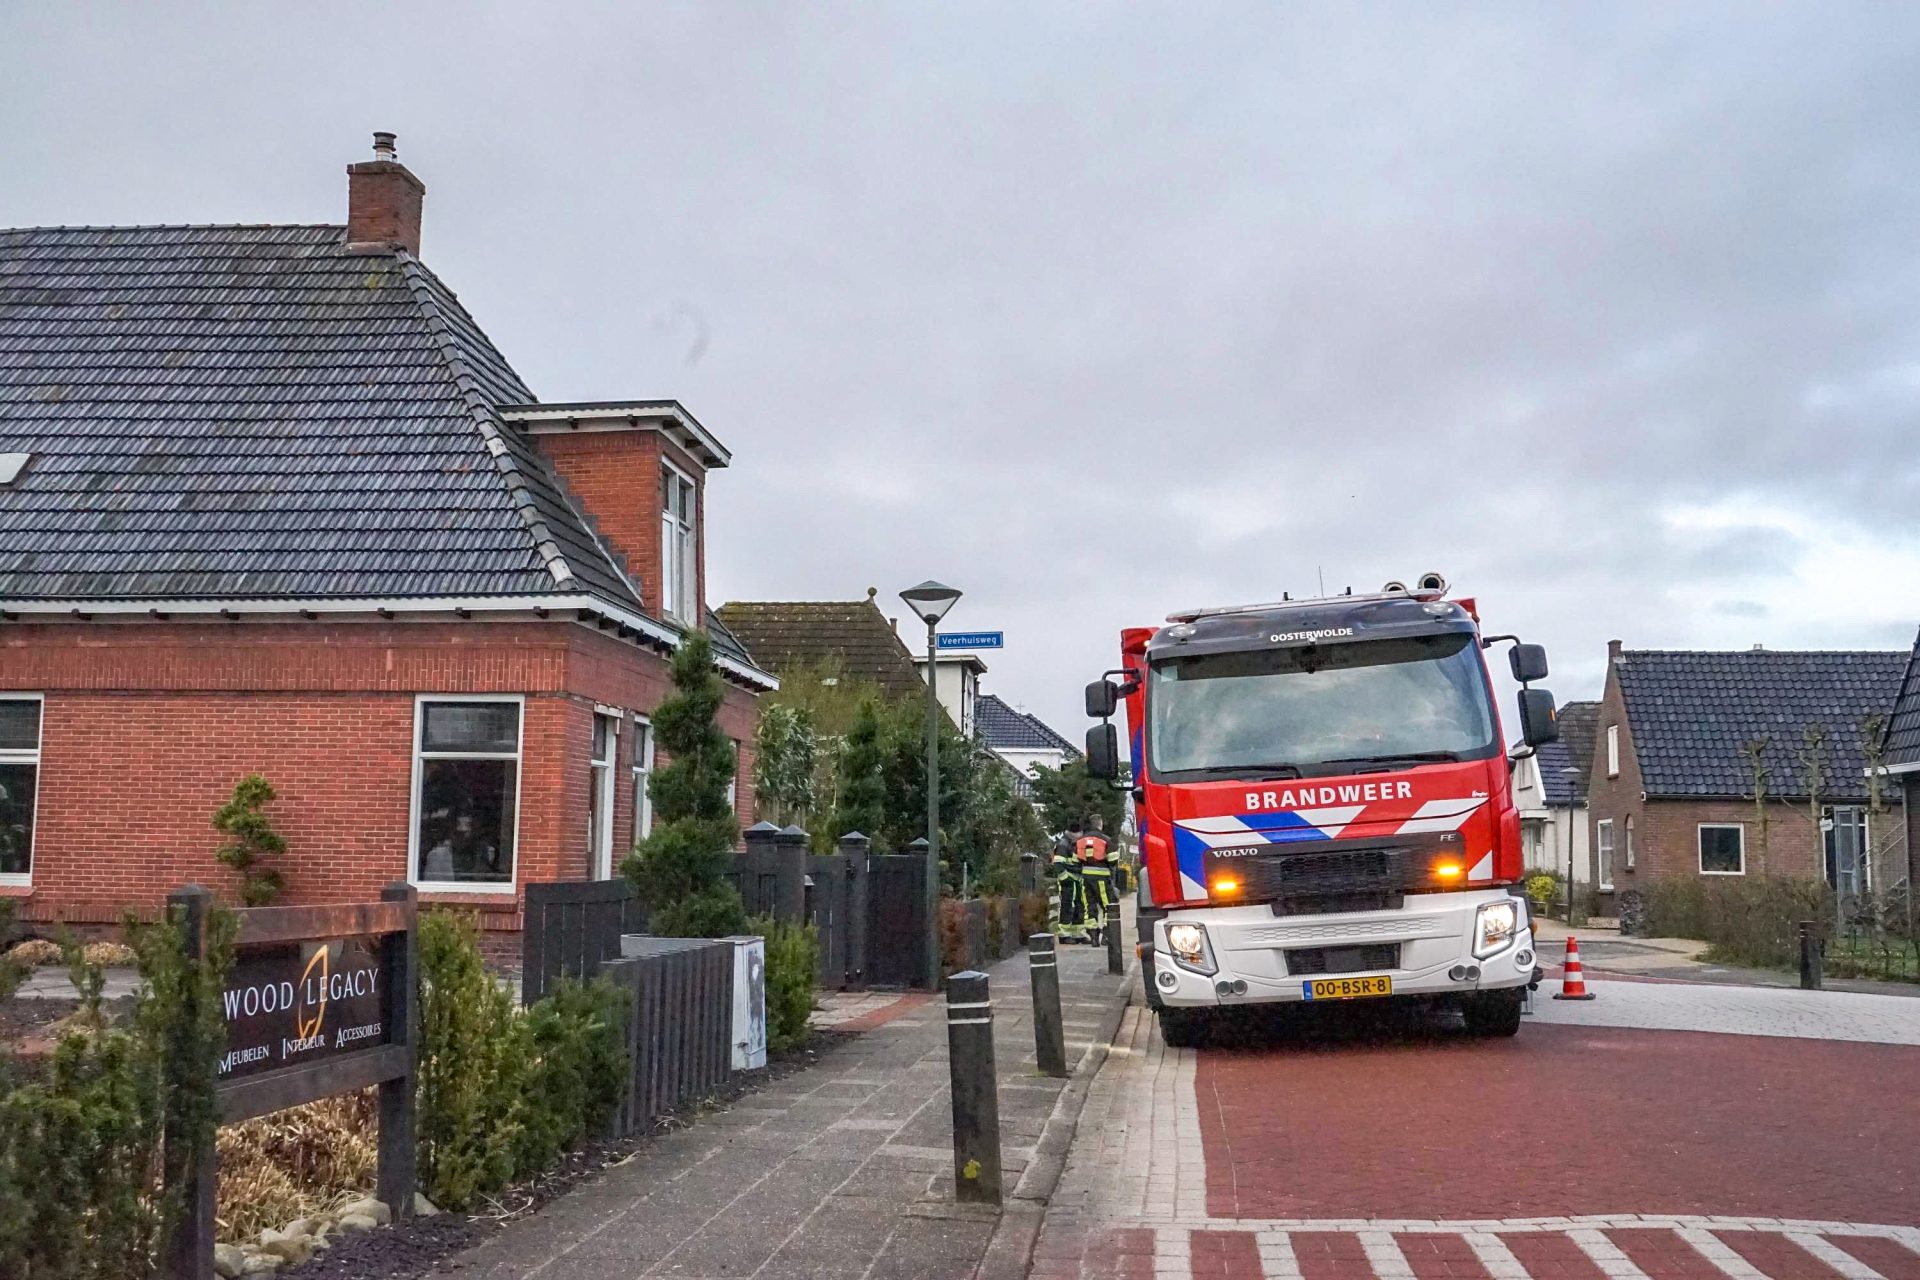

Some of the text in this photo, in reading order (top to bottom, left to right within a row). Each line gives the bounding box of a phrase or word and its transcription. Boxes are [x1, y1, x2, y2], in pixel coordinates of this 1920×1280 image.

[942, 636, 996, 645] Veerhuisweg
[1270, 628, 1354, 642] OOSTERWOLDE
[1246, 781, 1412, 810] BRANDWEER
[1440, 834, 1456, 842] FE
[1212, 848, 1258, 858] VOLVO
[223, 968, 379, 1021] WOOD LEGACY
[1316, 979, 1386, 996] 00-BSR-8
